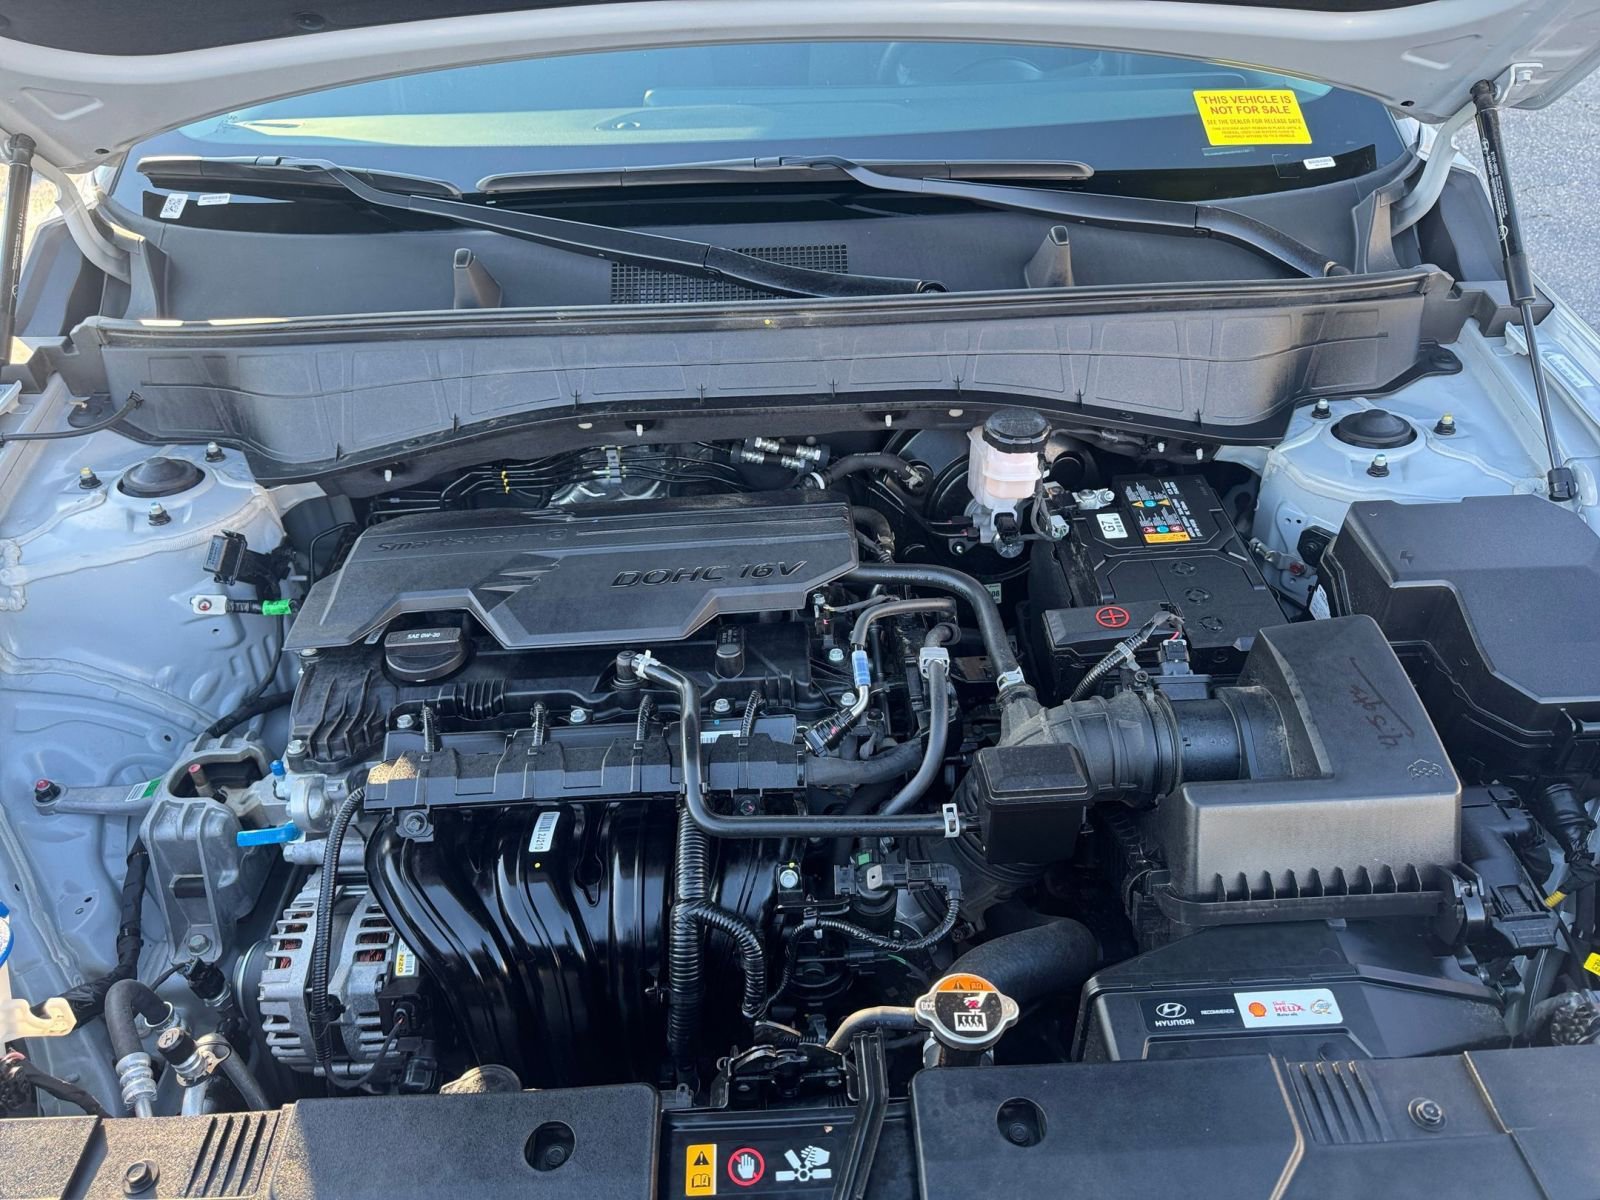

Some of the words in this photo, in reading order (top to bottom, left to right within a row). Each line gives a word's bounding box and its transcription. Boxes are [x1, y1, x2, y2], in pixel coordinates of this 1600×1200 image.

[1201, 95, 1228, 104] THIS
[1230, 95, 1279, 104] VEHICLE
[1281, 95, 1292, 104] IS
[1210, 106, 1233, 114] NOT
[1236, 106, 1260, 114] FOR
[1262, 105, 1291, 114] SALE
[1103, 520, 1117, 532] G7
[611, 564, 730, 588] DOHC
[739, 560, 808, 579] 16V
[1274, 1004, 1305, 1012] HELIX
[1155, 1018, 1195, 1027] HYUNDAI
